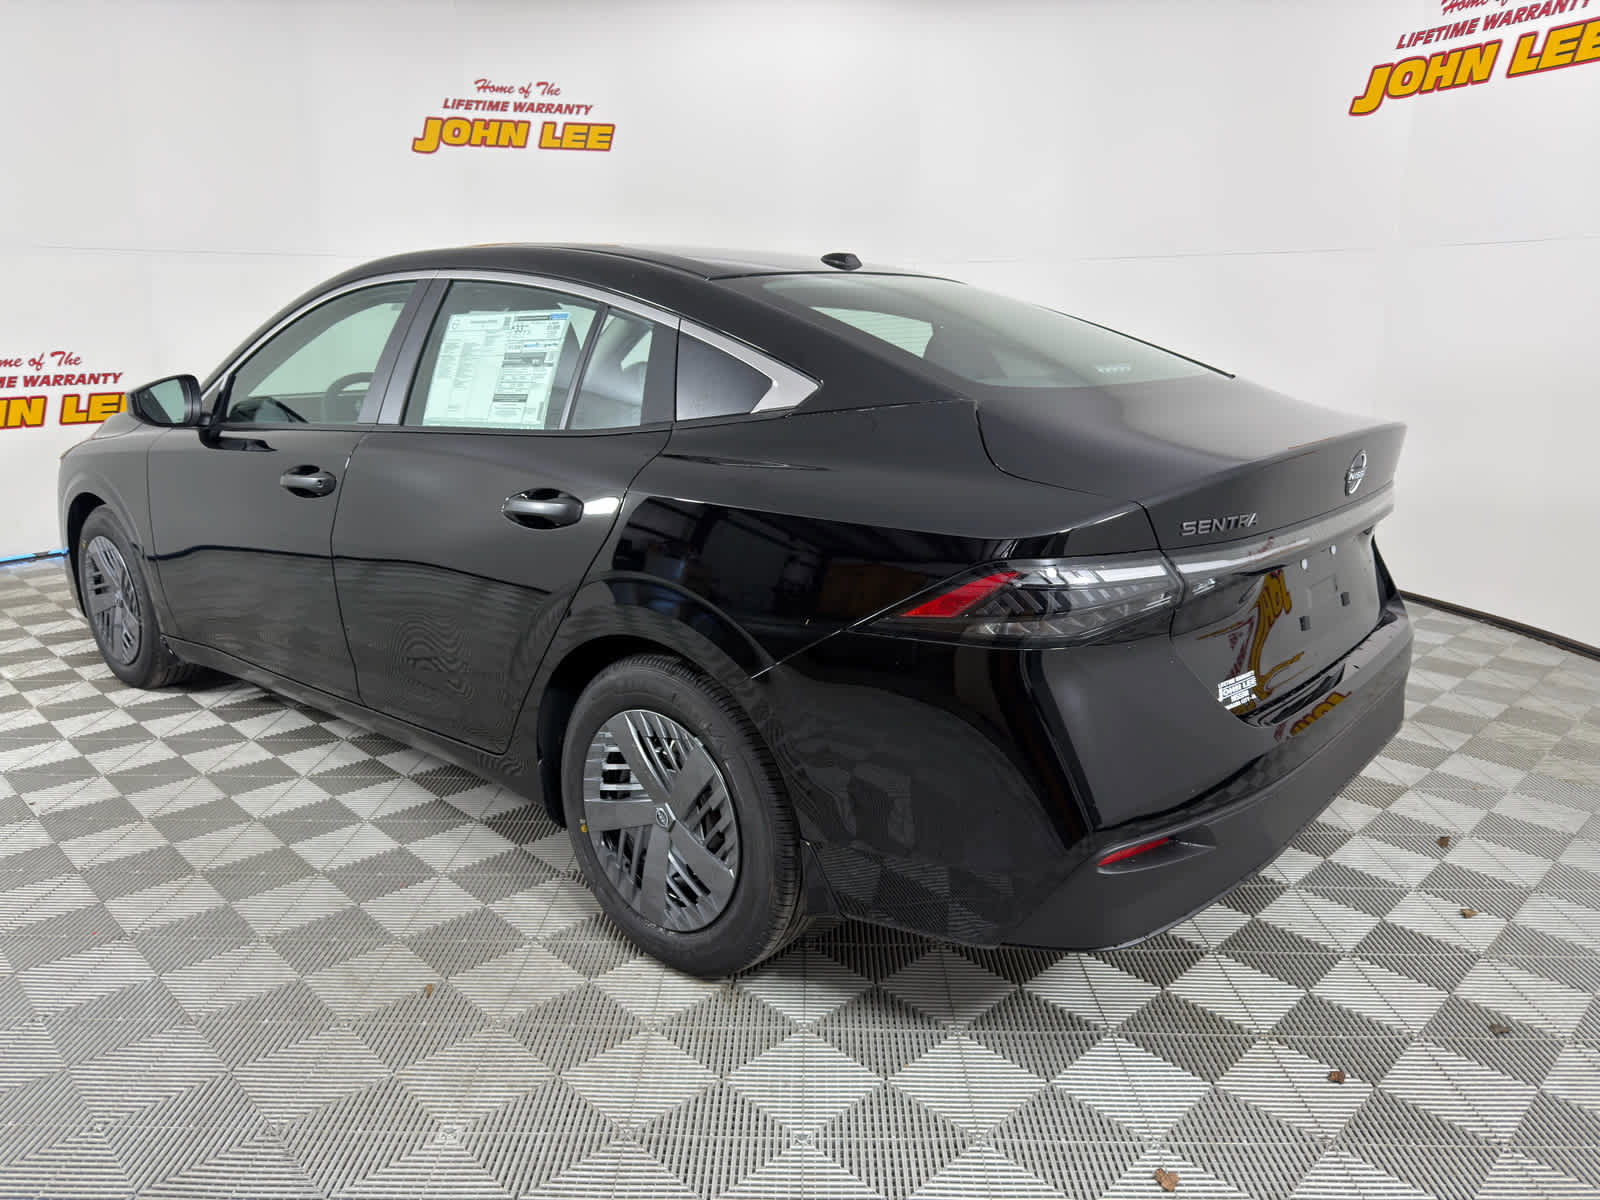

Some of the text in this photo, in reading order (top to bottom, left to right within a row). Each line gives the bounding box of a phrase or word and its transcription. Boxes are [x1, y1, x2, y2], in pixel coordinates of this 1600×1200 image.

[1396, 17, 1480, 50] LIFETIME
[1349, 16, 1600, 116] JOHN LEE
[474, 78, 561, 98] Home of The
[442, 98, 593, 116] LIFETIME WARRANTY
[412, 117, 616, 154] JOHN LEE
[28, 352, 45, 371] of
[50, 351, 82, 366] The
[23, 372, 123, 388] WARRANTY
[59, 391, 127, 427] LE
[1182, 512, 1257, 536] SENTRA
